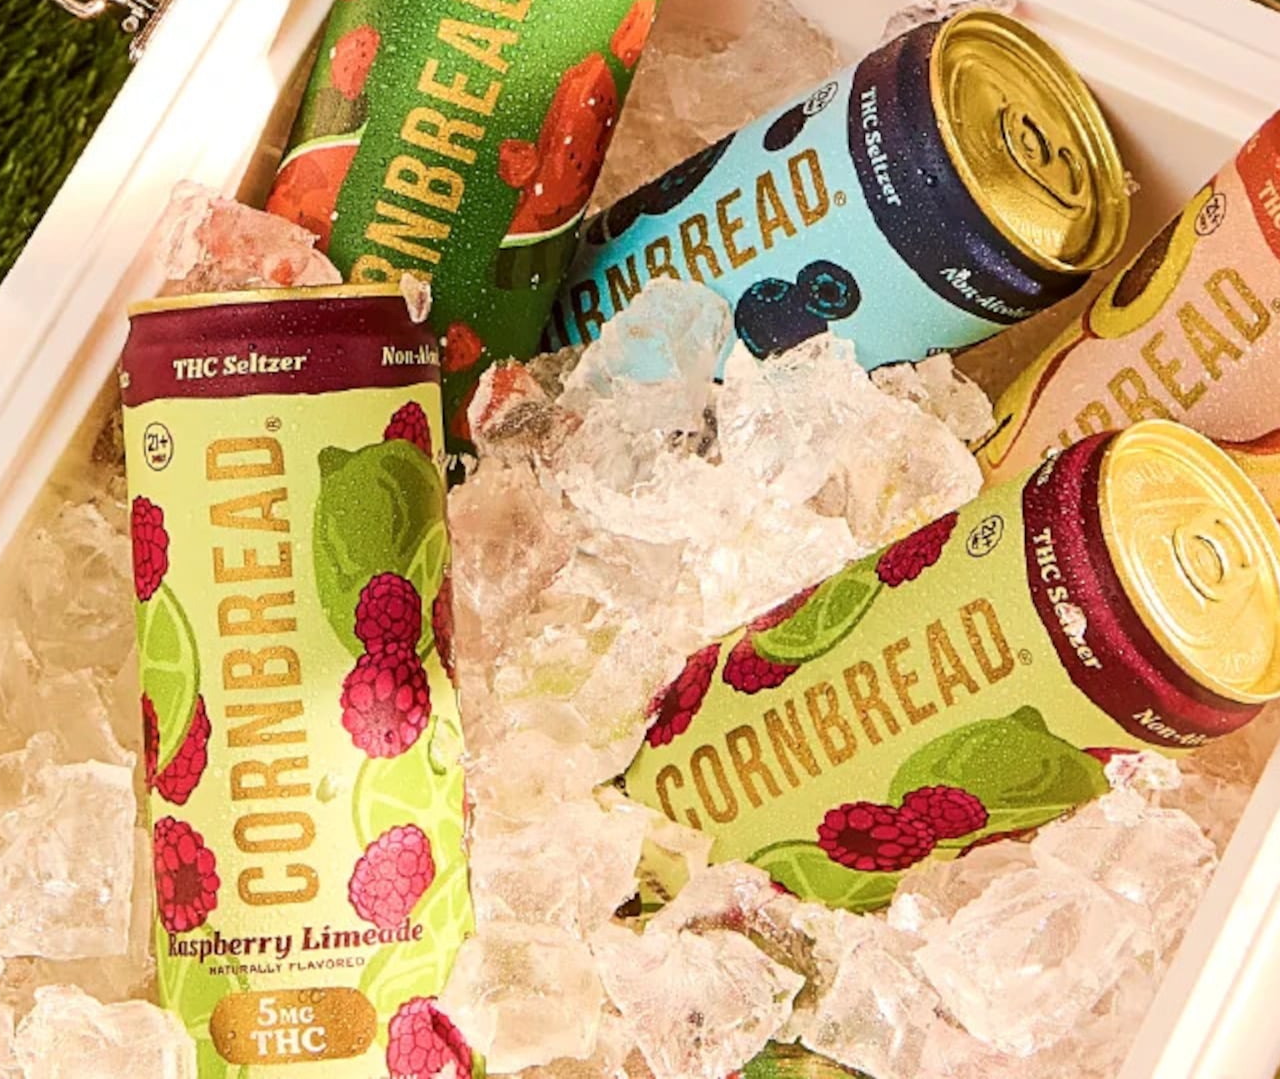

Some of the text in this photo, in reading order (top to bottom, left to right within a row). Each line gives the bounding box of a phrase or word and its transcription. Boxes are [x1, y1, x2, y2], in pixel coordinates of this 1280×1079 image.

[861, 85, 902, 207] THC Seltzer
[173, 356, 218, 380] THC
[222, 352, 307, 376] Seltzer
[147, 433, 169, 452] 21+
[1033, 527, 1062, 584] THC
[1046, 585, 1103, 669] Sezer
[206, 434, 320, 907] CORNBREAD
[655, 597, 1016, 831] CORNBREAD
[167, 918, 424, 964] Raspberry Limeade
[209, 956, 365, 976] NATURALLY FLAVORED
[257, 997, 315, 1027] 5MG
[250, 1027, 327, 1056] THC
